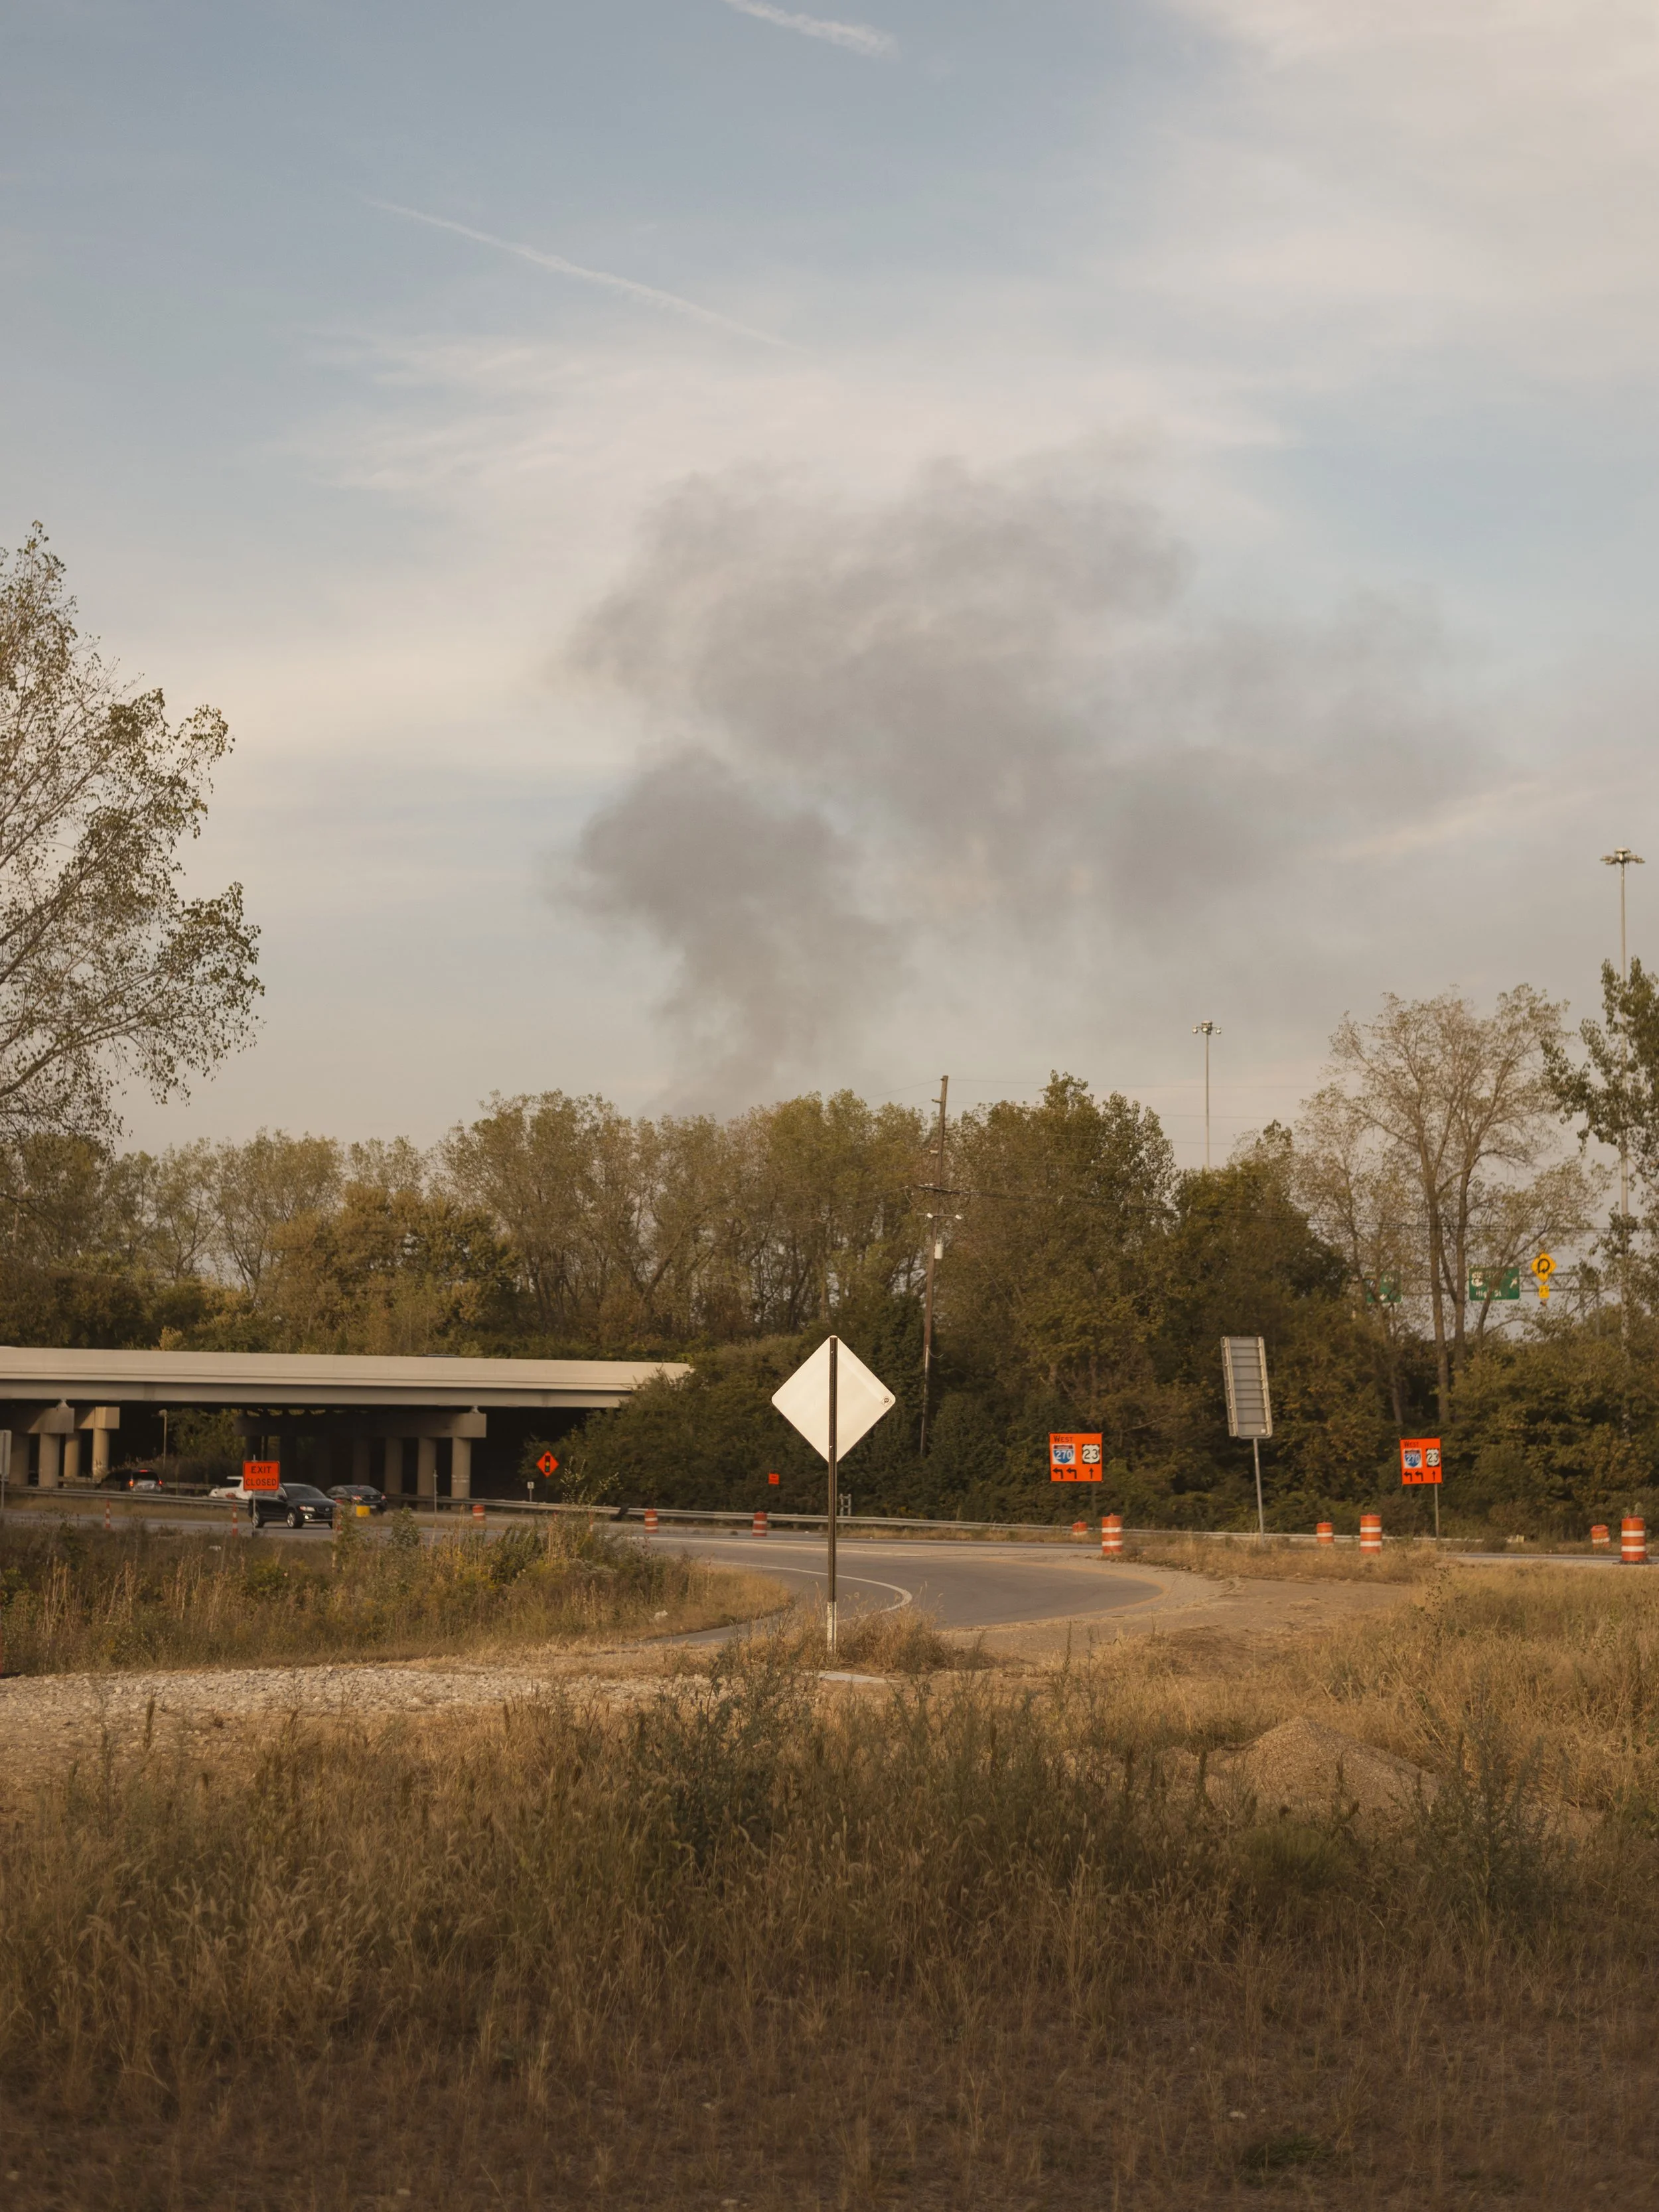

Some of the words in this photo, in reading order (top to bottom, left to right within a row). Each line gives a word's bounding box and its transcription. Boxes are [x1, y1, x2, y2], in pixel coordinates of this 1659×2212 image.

[1055, 1450, 1072, 1460] 270
[1084, 1448, 1099, 1460] 23
[1406, 1454, 1420, 1464] 270
[1427, 1452, 1439, 1463] 23
